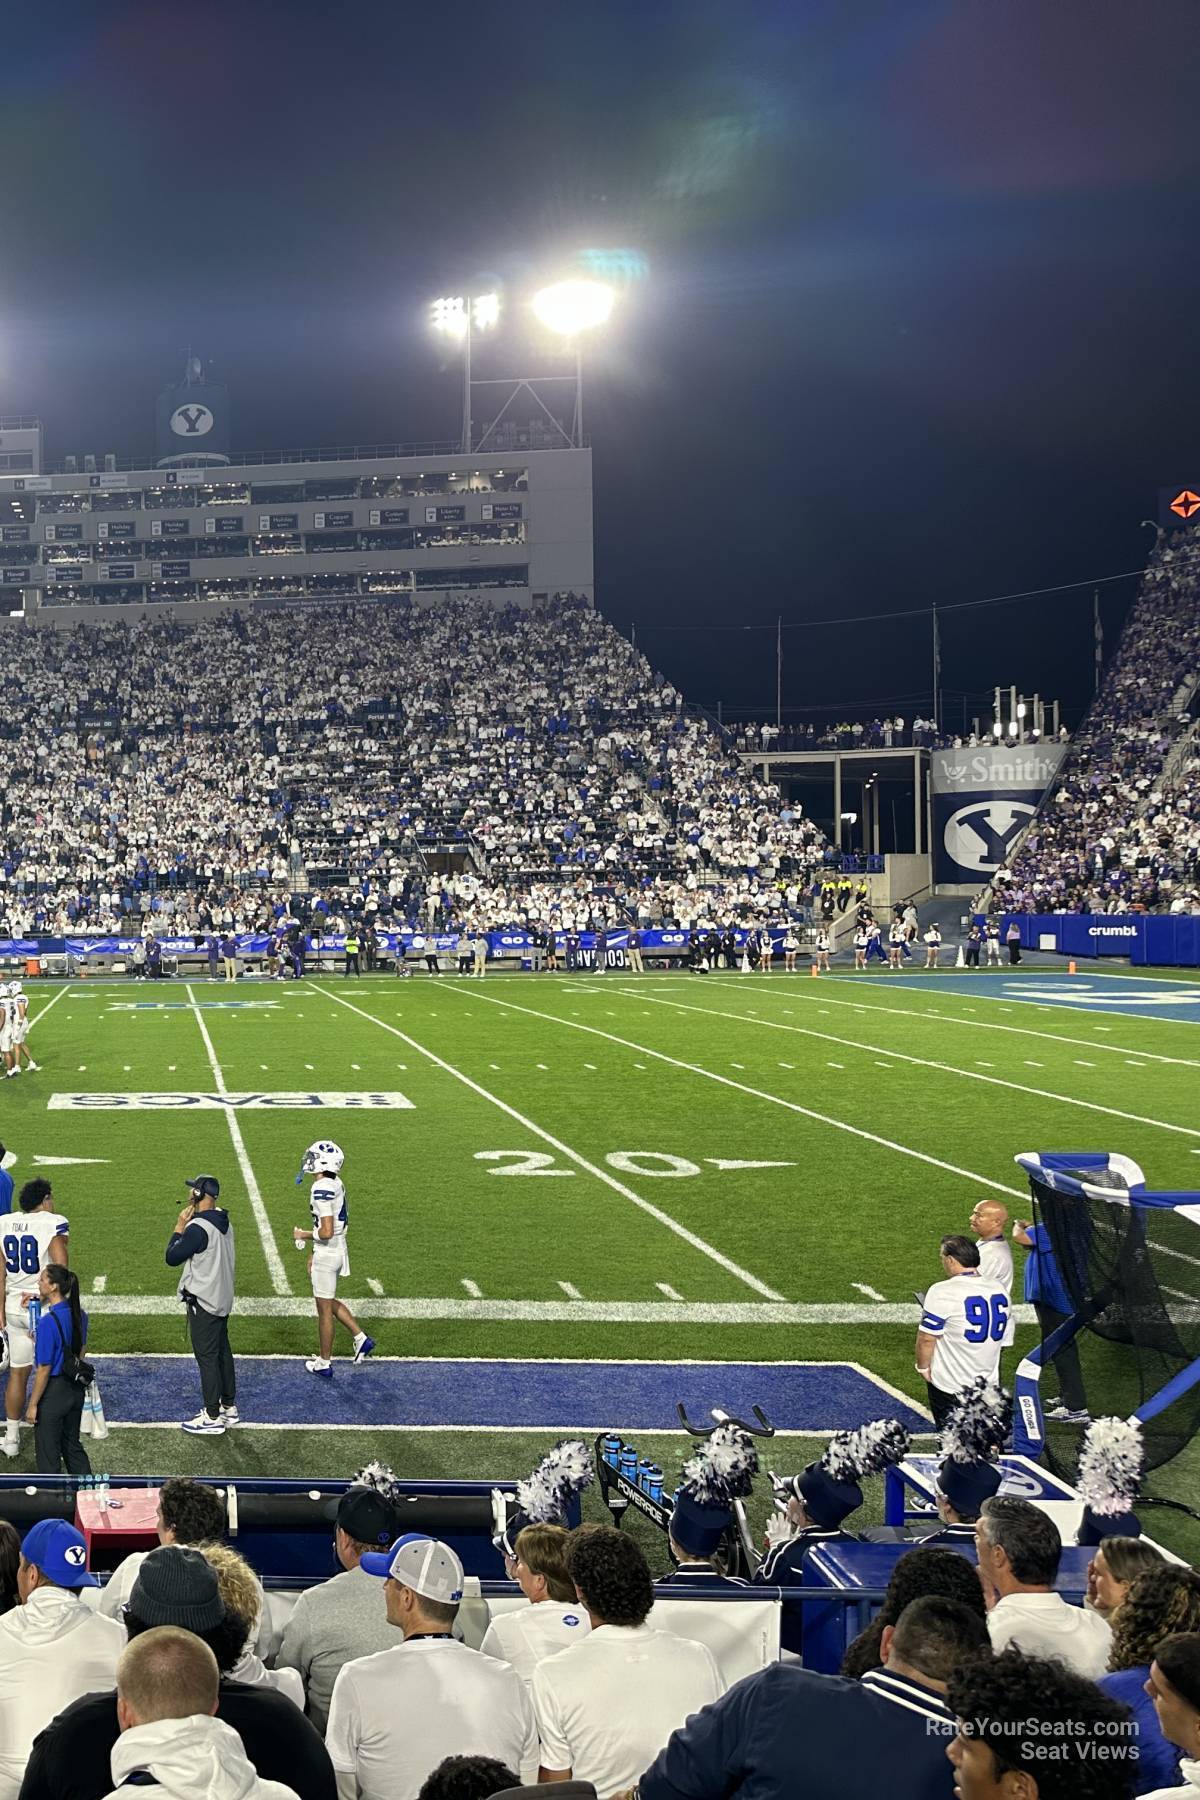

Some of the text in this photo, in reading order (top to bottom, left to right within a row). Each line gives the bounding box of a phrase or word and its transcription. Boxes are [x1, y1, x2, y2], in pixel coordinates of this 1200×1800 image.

[502, 936, 523, 944] GO
[662, 934, 683, 943] GO
[1089, 926, 1138, 936] crumbl
[493, 949, 502, 957] 10
[473, 1150, 701, 1177] 20
[3, 1235, 39, 1275] 98
[964, 1293, 1008, 1343] 96
[618, 1479, 664, 1525] POWERADE
